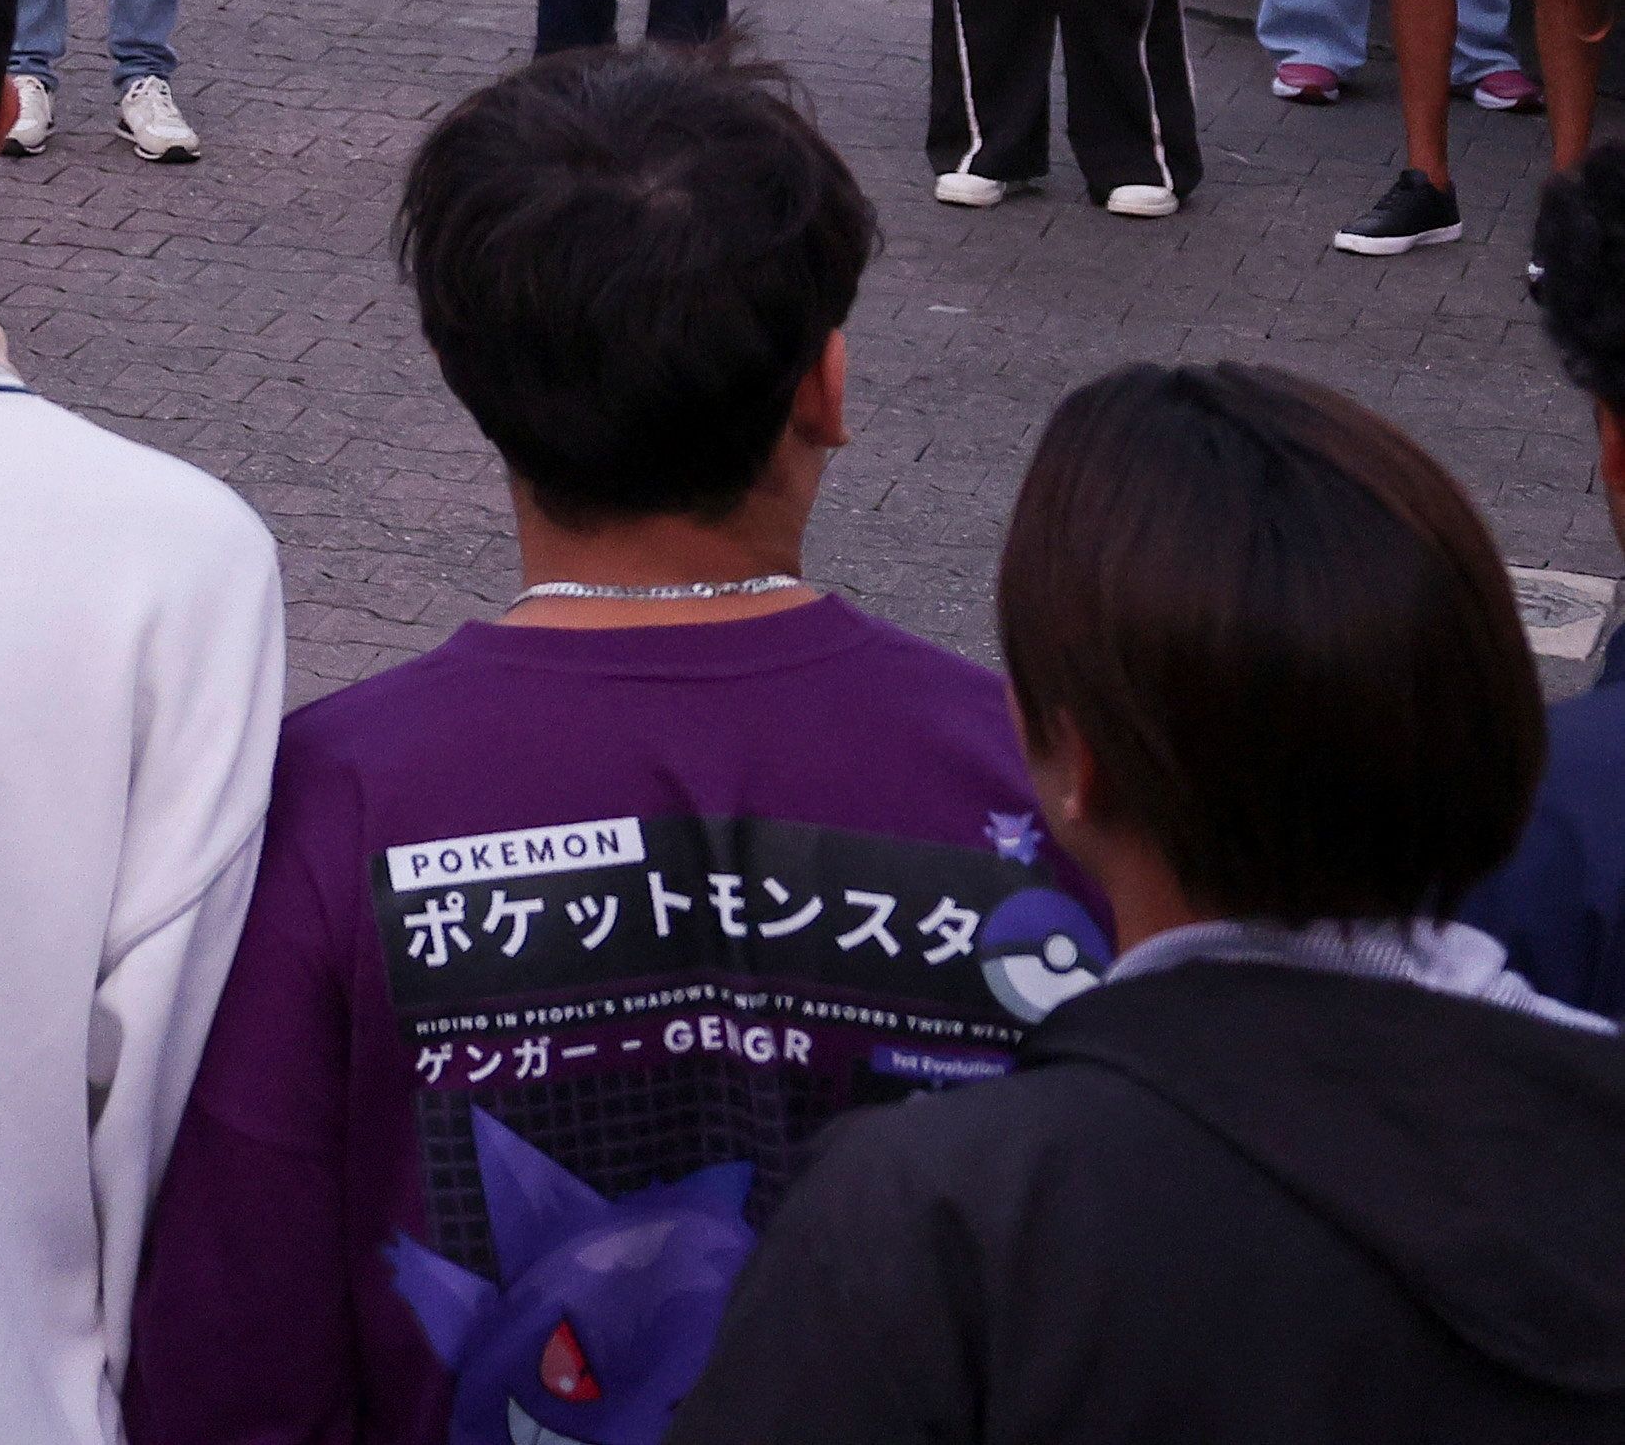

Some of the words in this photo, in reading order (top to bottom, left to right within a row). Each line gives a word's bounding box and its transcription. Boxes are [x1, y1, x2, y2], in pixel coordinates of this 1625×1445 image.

[411, 828, 621, 879] POKEMON
[402, 870, 981, 968] ポケットモンスタ
[416, 1013, 490, 1036] HIDING
[495, 1012, 518, 1029] IN
[415, 1035, 598, 1085] ゲンガー
